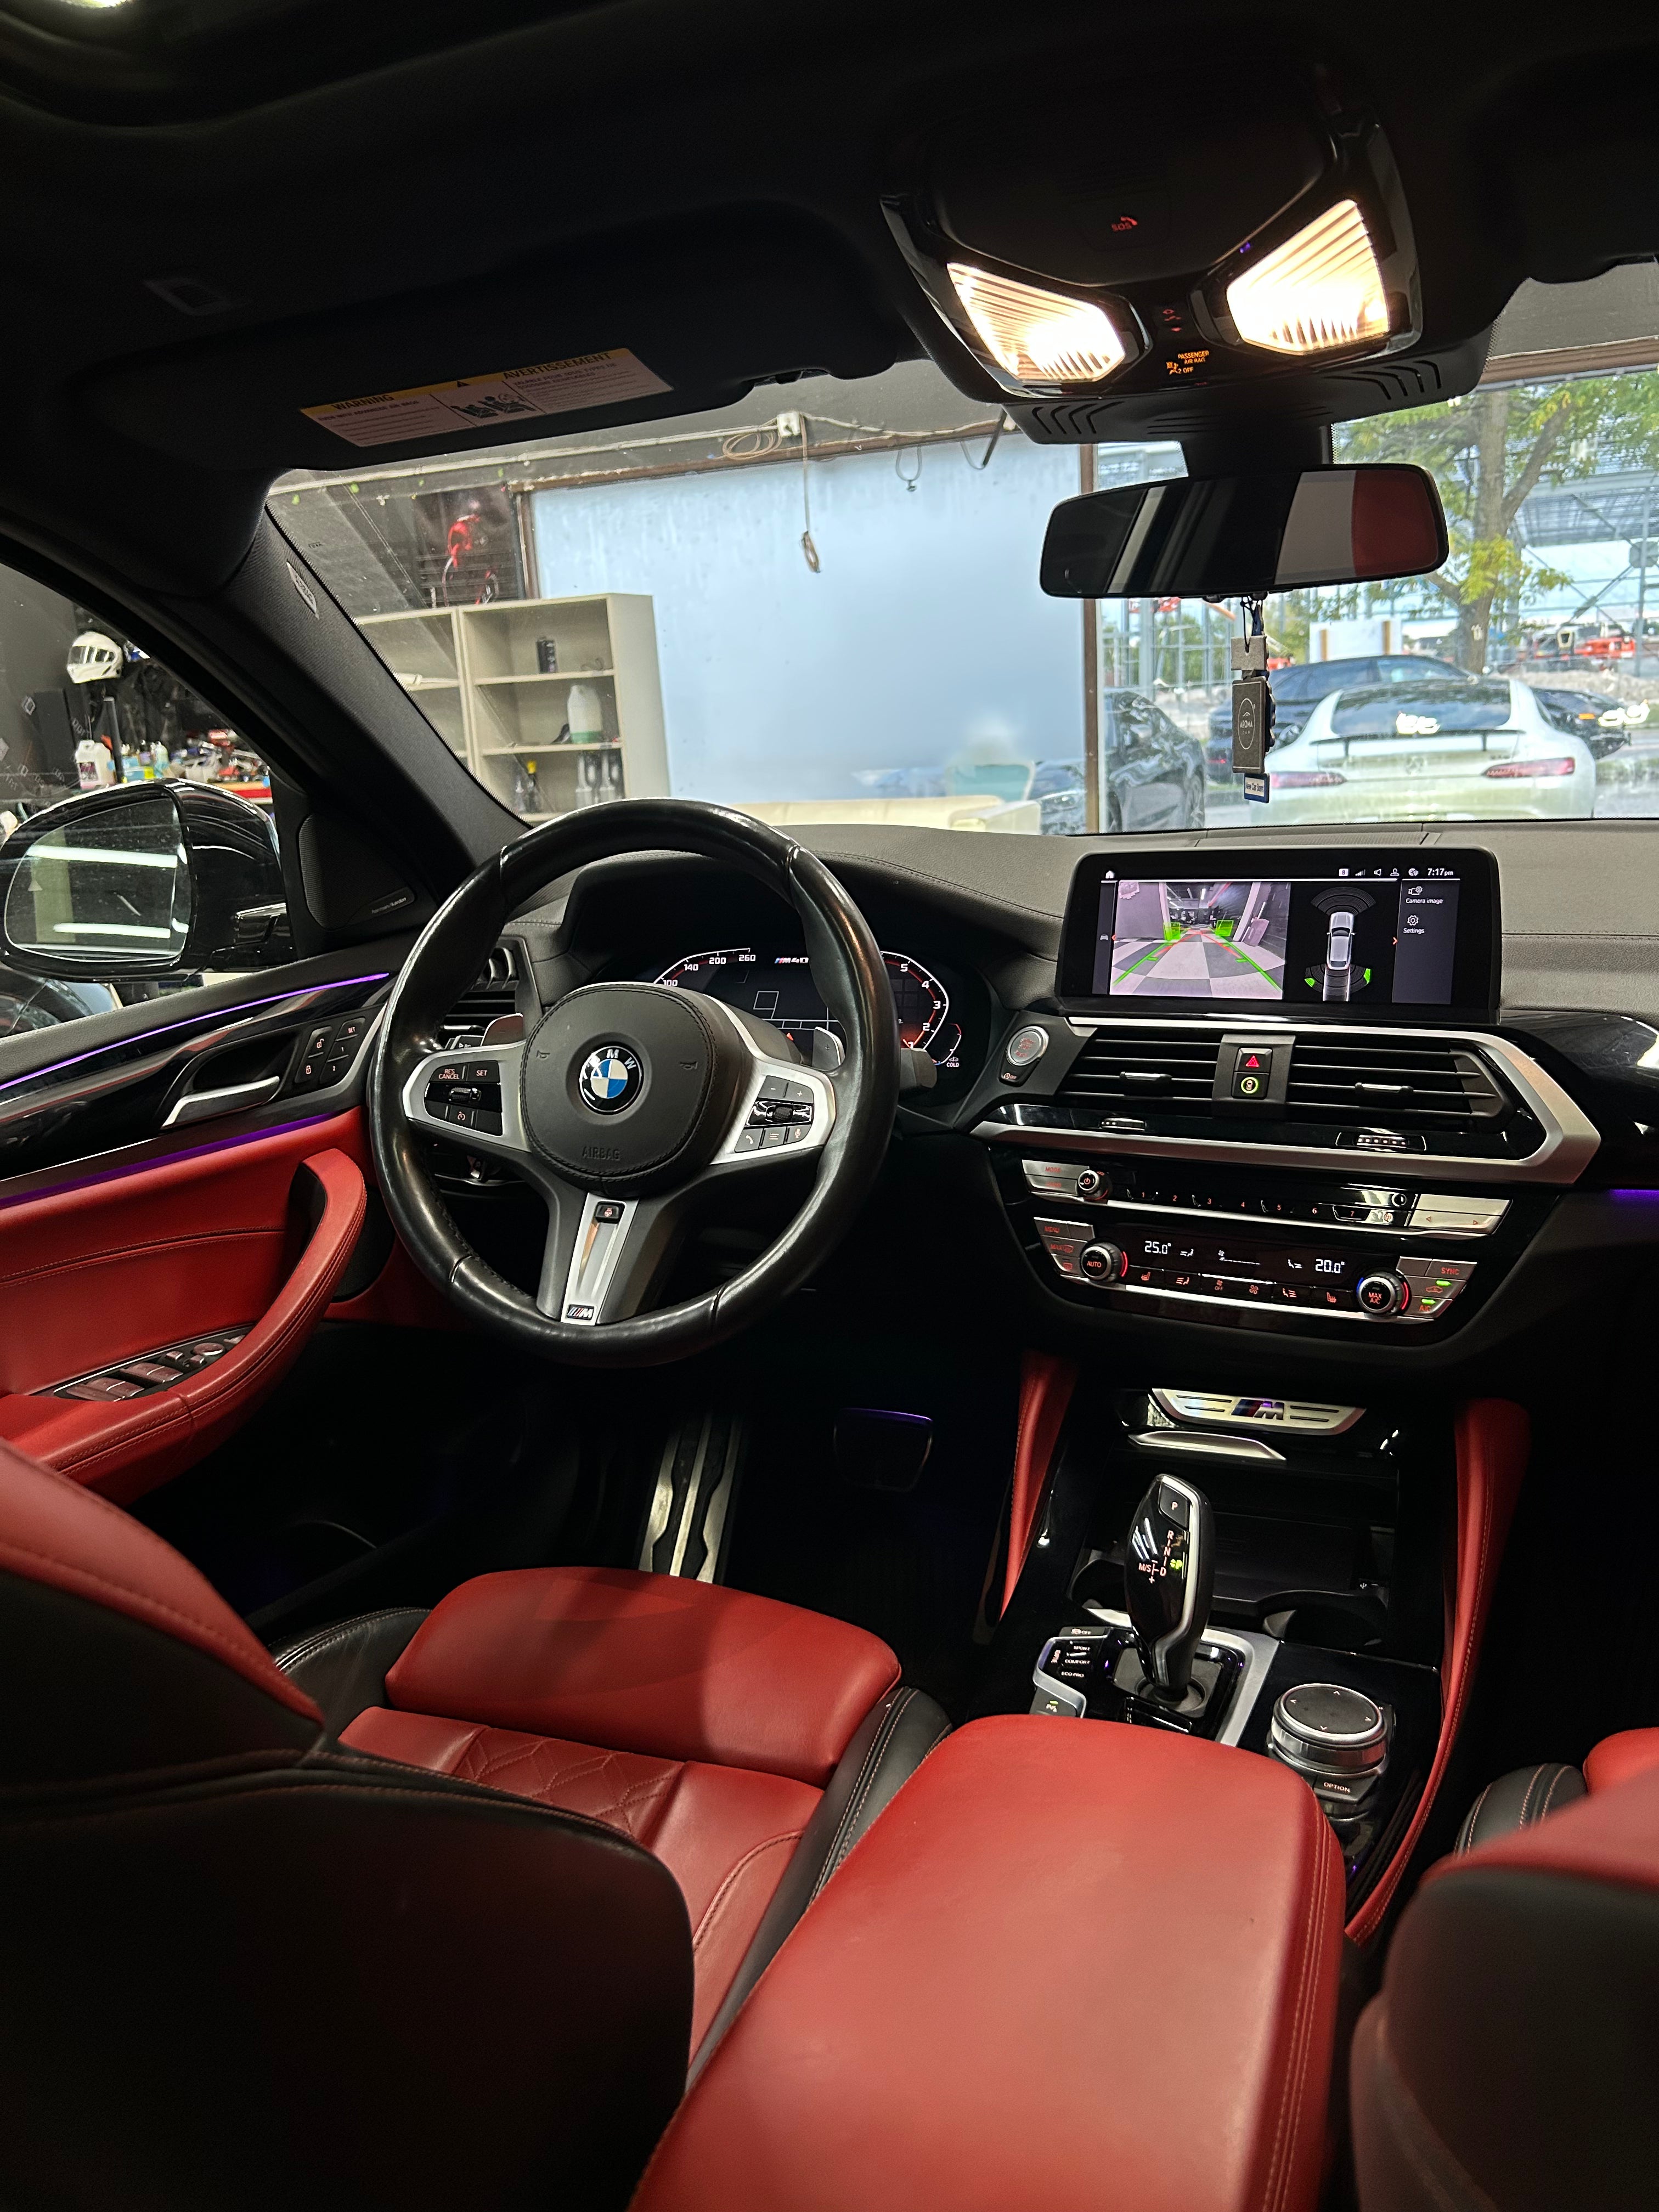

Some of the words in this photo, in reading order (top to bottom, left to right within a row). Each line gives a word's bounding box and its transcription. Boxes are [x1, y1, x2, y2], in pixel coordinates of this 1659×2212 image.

[1111, 223, 1132, 232] SOS
[1177, 350, 1209, 359] PASSENGER
[503, 352, 612, 380] AVERTISSEMENT
[331, 394, 394, 410] WARNING
[1240, 720, 1253, 728] AROMA
[900, 964, 908, 972] 5
[933, 1001, 941, 1009] 3
[923, 1023, 930, 1031] 2
[582, 1146, 620, 1161] AIRBAG
[1441, 1267, 1459, 1276] SYNC
[1171, 1502, 1178, 1510] P
[1167, 1530, 1175, 1540] R
[1164, 1546, 1171, 1556] N
[1138, 1562, 1152, 1572] M/S
[1160, 1567, 1166, 1577] D
[1324, 1782, 1351, 1793] OPTION
